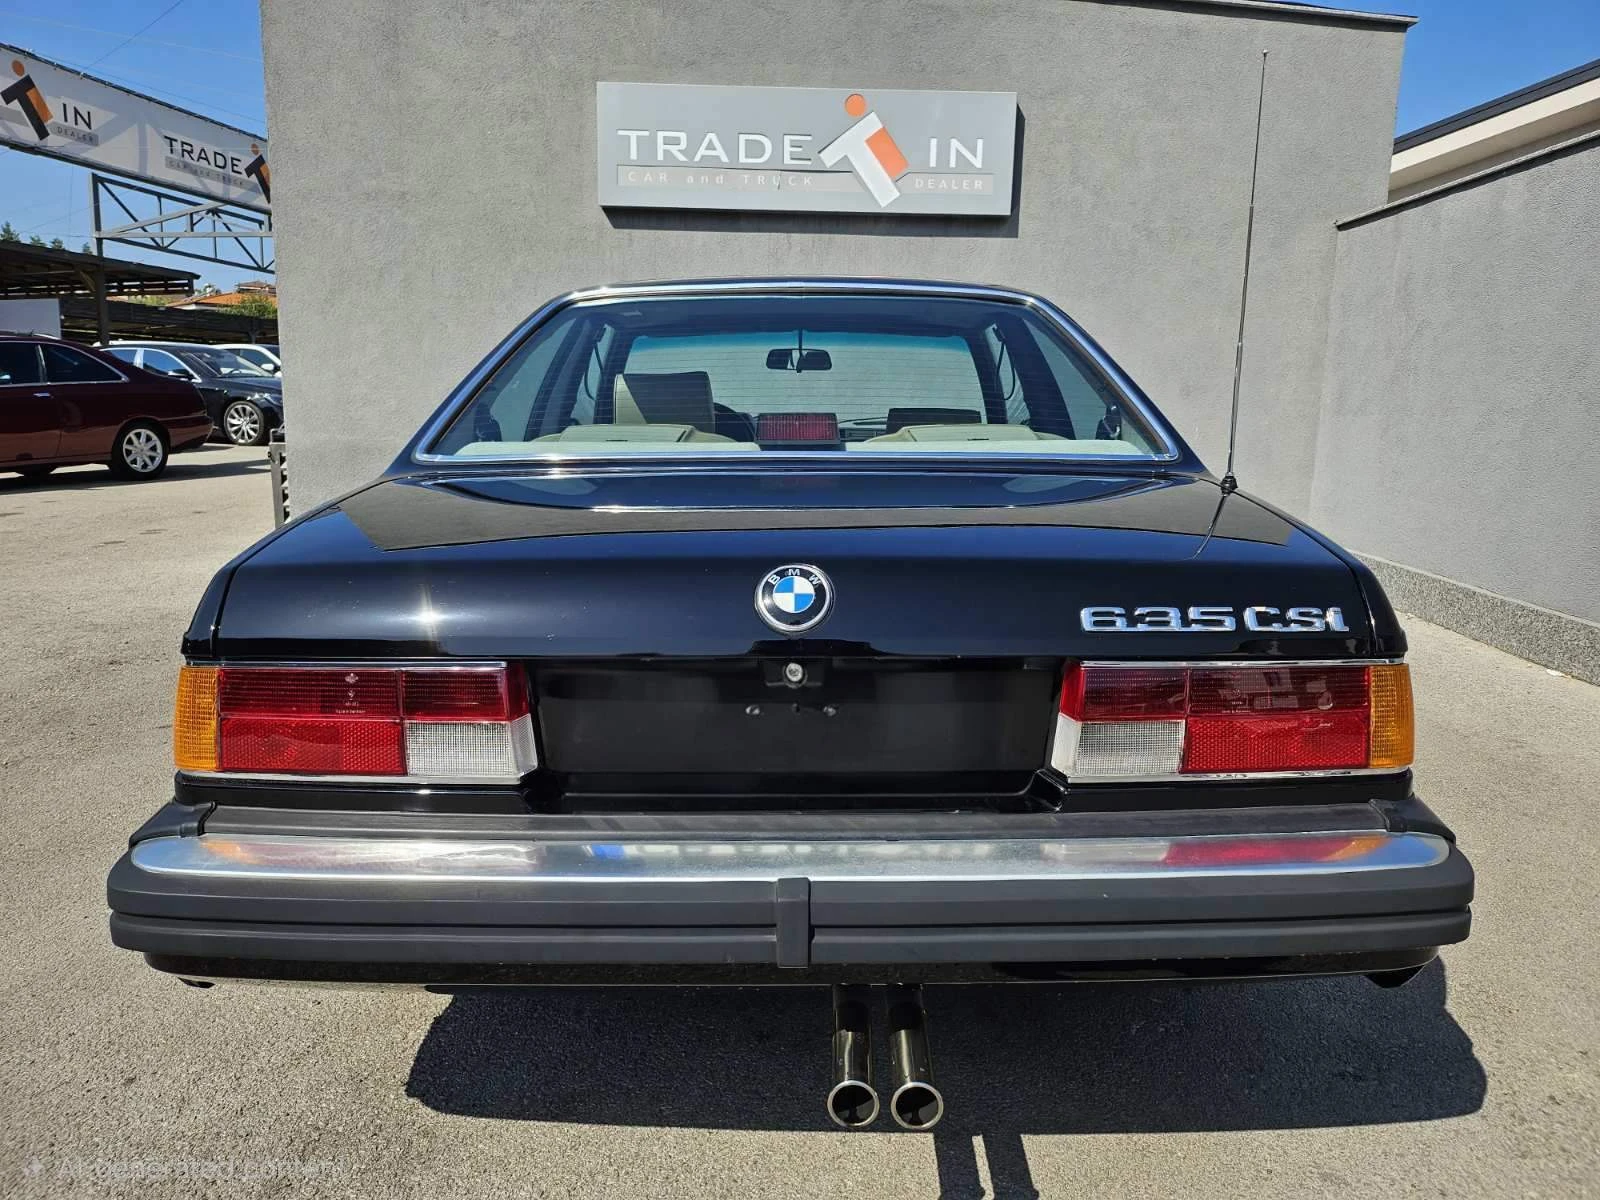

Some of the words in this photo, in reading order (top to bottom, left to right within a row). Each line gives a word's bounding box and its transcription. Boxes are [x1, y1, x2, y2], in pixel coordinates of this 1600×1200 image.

[62, 103, 92, 130] IN
[163, 135, 243, 175] TRADE
[616, 129, 813, 165] TRADE
[929, 137, 984, 168] IN
[627, 171, 669, 183] CAR
[686, 173, 725, 185] and
[742, 174, 814, 186] TRUCK
[915, 178, 984, 190] DEALER
[768, 568, 821, 587] BMW
